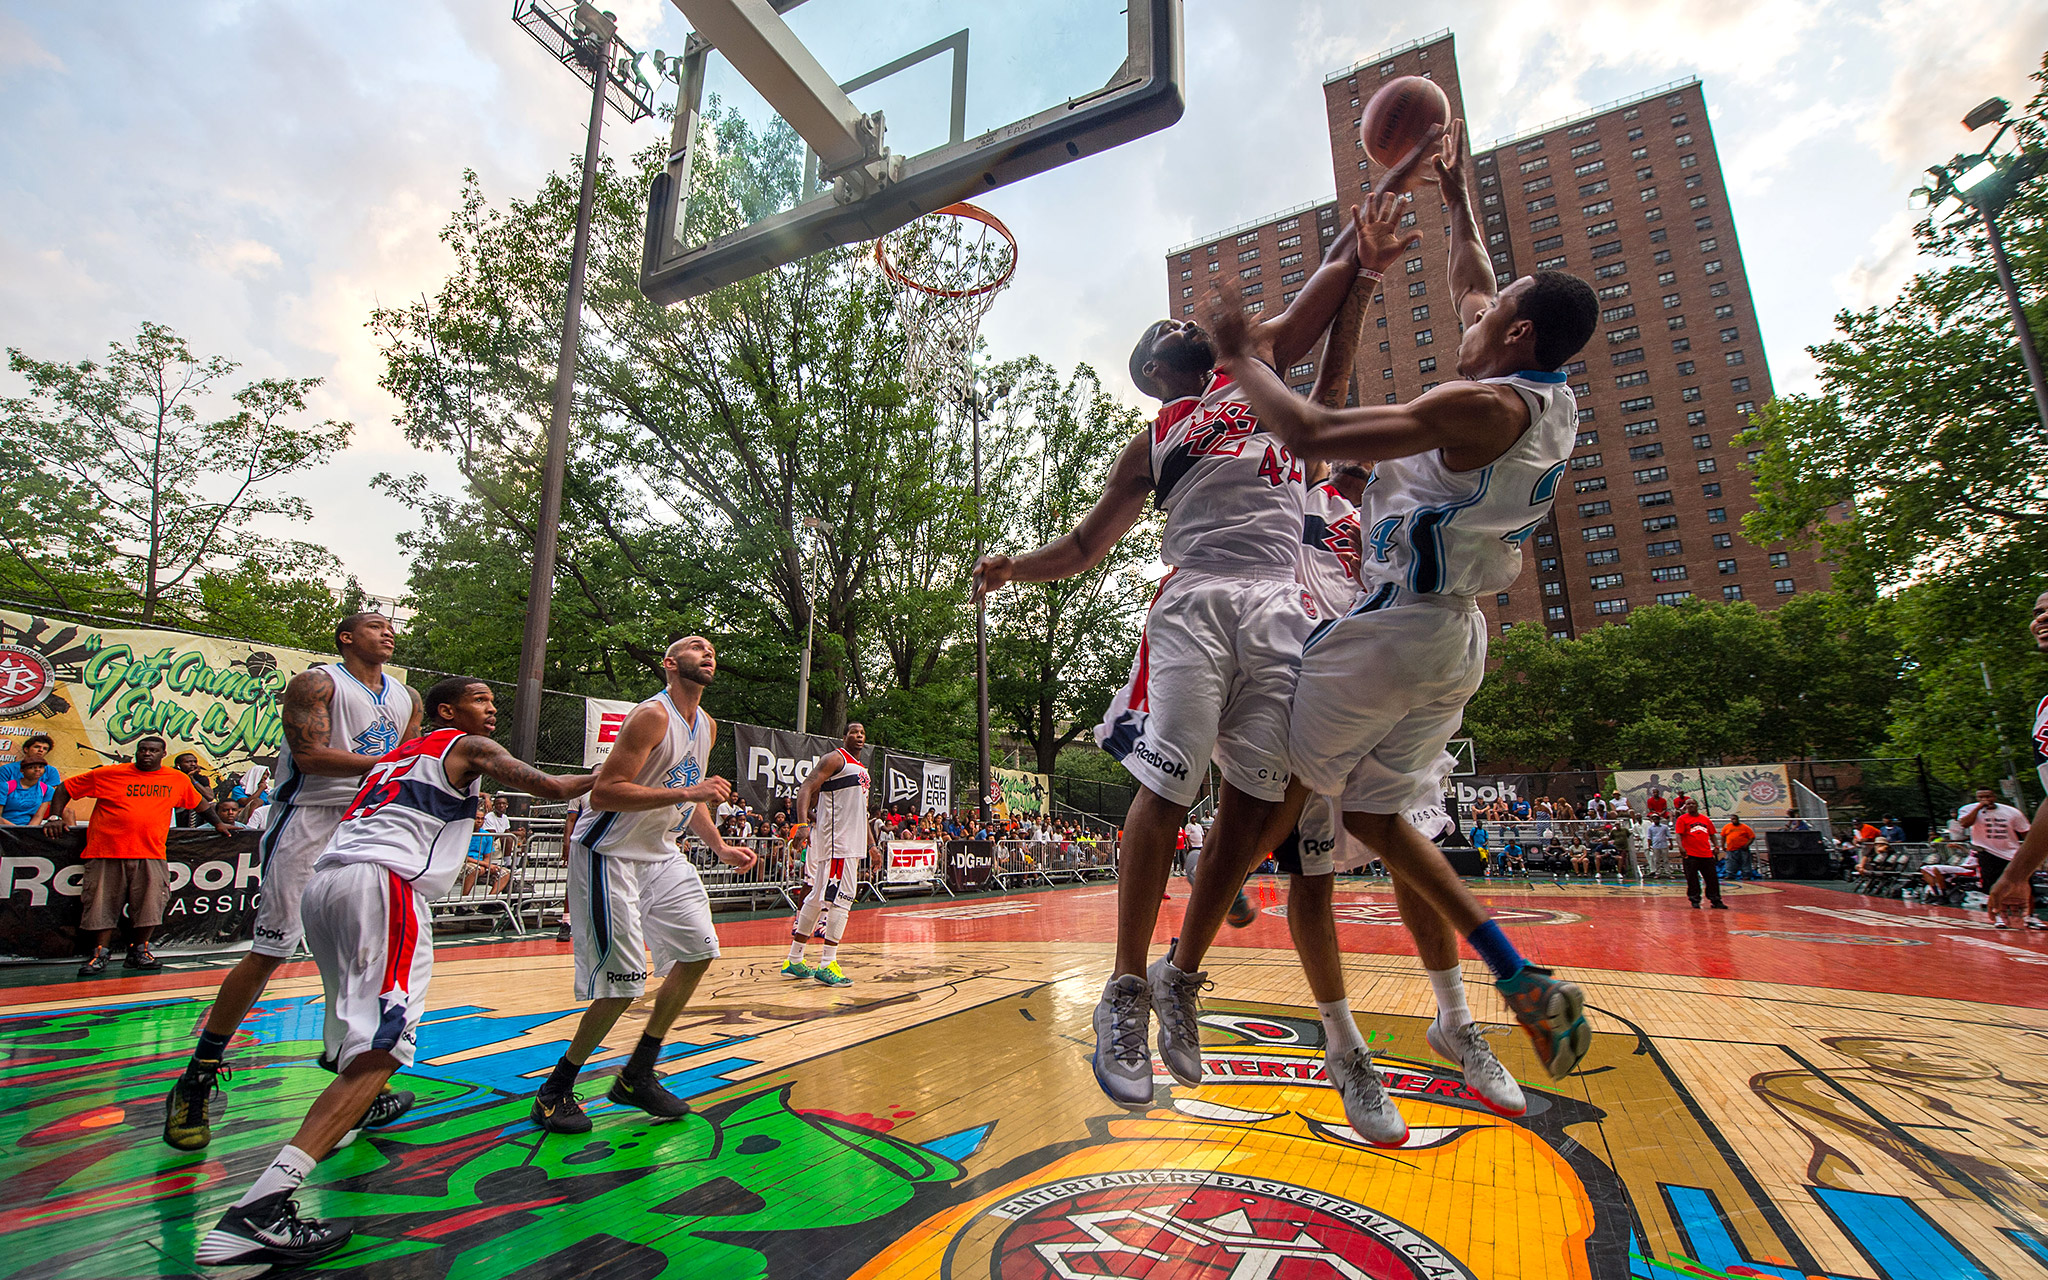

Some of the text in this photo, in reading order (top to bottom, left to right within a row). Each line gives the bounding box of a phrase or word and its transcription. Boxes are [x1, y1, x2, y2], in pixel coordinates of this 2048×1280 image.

[1257, 443, 1303, 487] 42
[107, 685, 285, 758] Earn a Na
[596, 746, 611, 754] THE
[748, 746, 821, 789] Ree
[1135, 741, 1189, 781] Reebok
[927, 774, 947, 790] NEW
[126, 784, 173, 798] SECURITY
[926, 790, 947, 806] ERA
[1441, 781, 1517, 802] bok
[1303, 839, 1335, 856] Ree
[891, 849, 935, 867] ESPN
[975, 857, 992, 866] FILM
[256, 925, 286, 941] bok
[606, 971, 647, 984] Reebo
[999, 1172, 1405, 1242] ENTERTAINERS BASKETBALL
